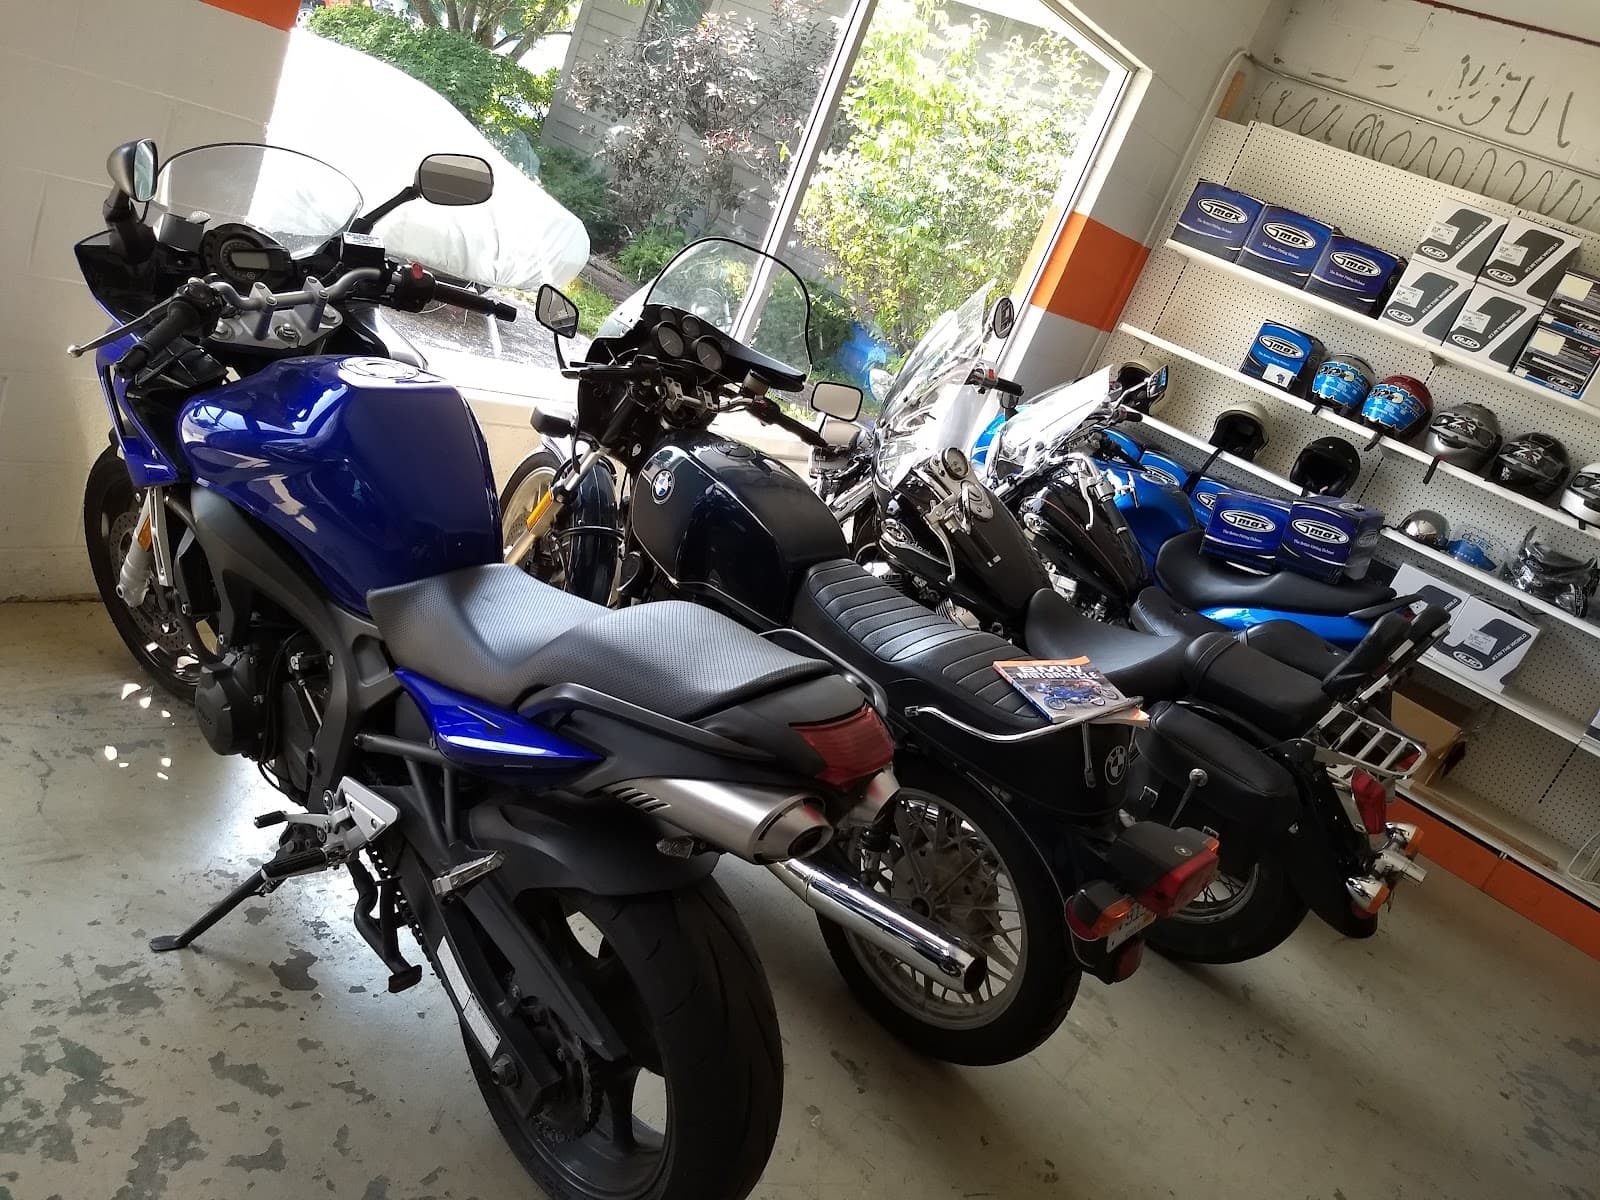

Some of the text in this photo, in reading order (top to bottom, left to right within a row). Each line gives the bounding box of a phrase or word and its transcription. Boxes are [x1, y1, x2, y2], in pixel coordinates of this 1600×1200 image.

[1221, 510, 1274, 532] Gmax
[1293, 520, 1347, 543] Gmax
[1510, 633, 1527, 646] WORLD
[1016, 671, 1099, 680] MOTORCYCLE
[1017, 665, 1082, 673] BMW
